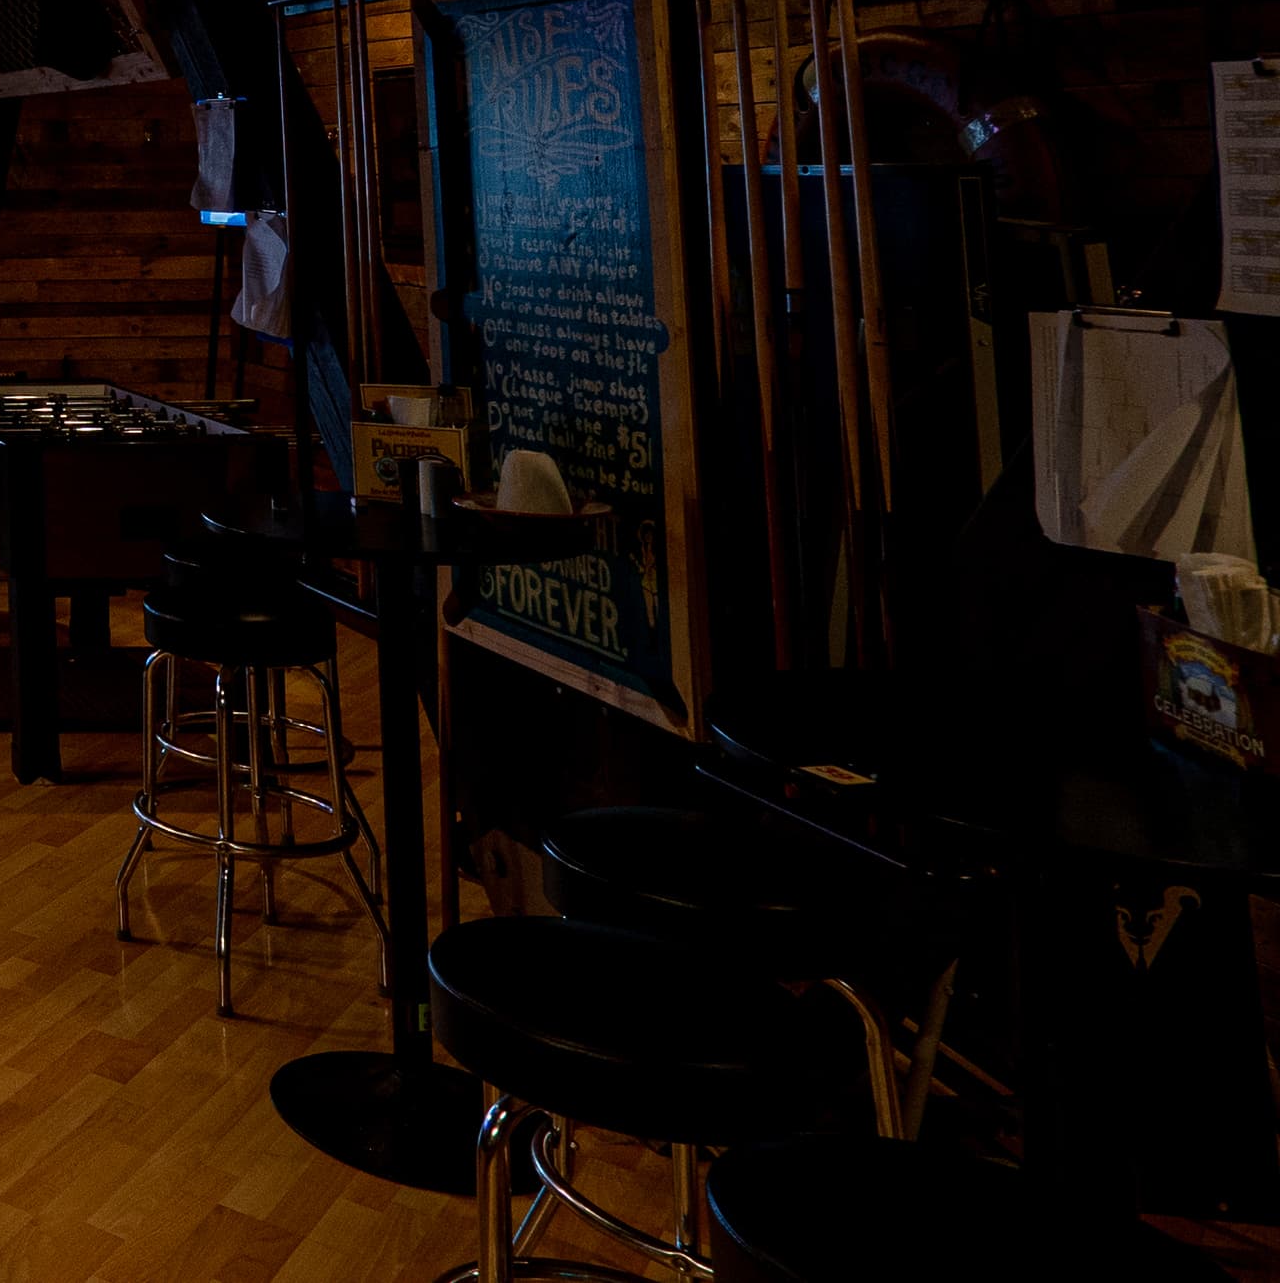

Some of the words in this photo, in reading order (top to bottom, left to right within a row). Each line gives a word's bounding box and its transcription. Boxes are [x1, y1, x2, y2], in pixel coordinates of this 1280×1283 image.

[492, 55, 621, 134] RULES
[548, 255, 583, 278] ANY
[538, 287, 552, 300] or
[557, 282, 592, 303] drink
[534, 302, 583, 320] around
[587, 306, 609, 325] the
[516, 320, 553, 338] must
[556, 325, 611, 350] always
[615, 331, 656, 355] have
[532, 342, 567, 360] foot
[570, 347, 591, 365] on
[594, 348, 626, 370] the
[566, 371, 605, 396] jump
[513, 404, 536, 421] not
[575, 417, 604, 437] the
[584, 435, 618, 462] fine
[599, 465, 618, 489] be
[1153, 694, 1266, 758] CELEBRATION
